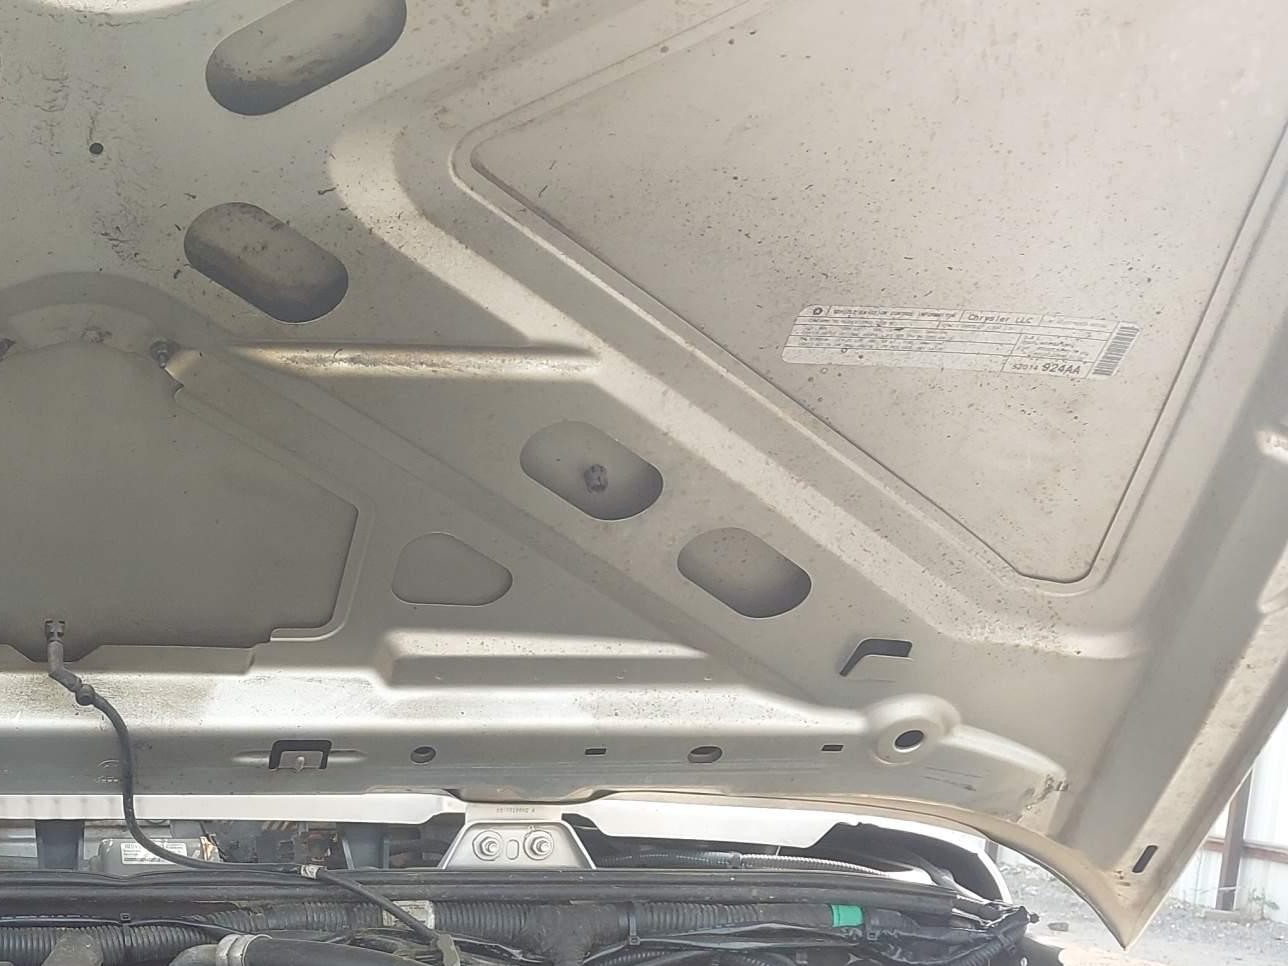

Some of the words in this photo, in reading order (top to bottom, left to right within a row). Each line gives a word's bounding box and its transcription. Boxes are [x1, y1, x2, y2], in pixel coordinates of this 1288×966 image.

[967, 313, 1010, 323] Chrysler
[1015, 316, 1034, 324] LLC
[1041, 363, 1081, 375] 924AA
